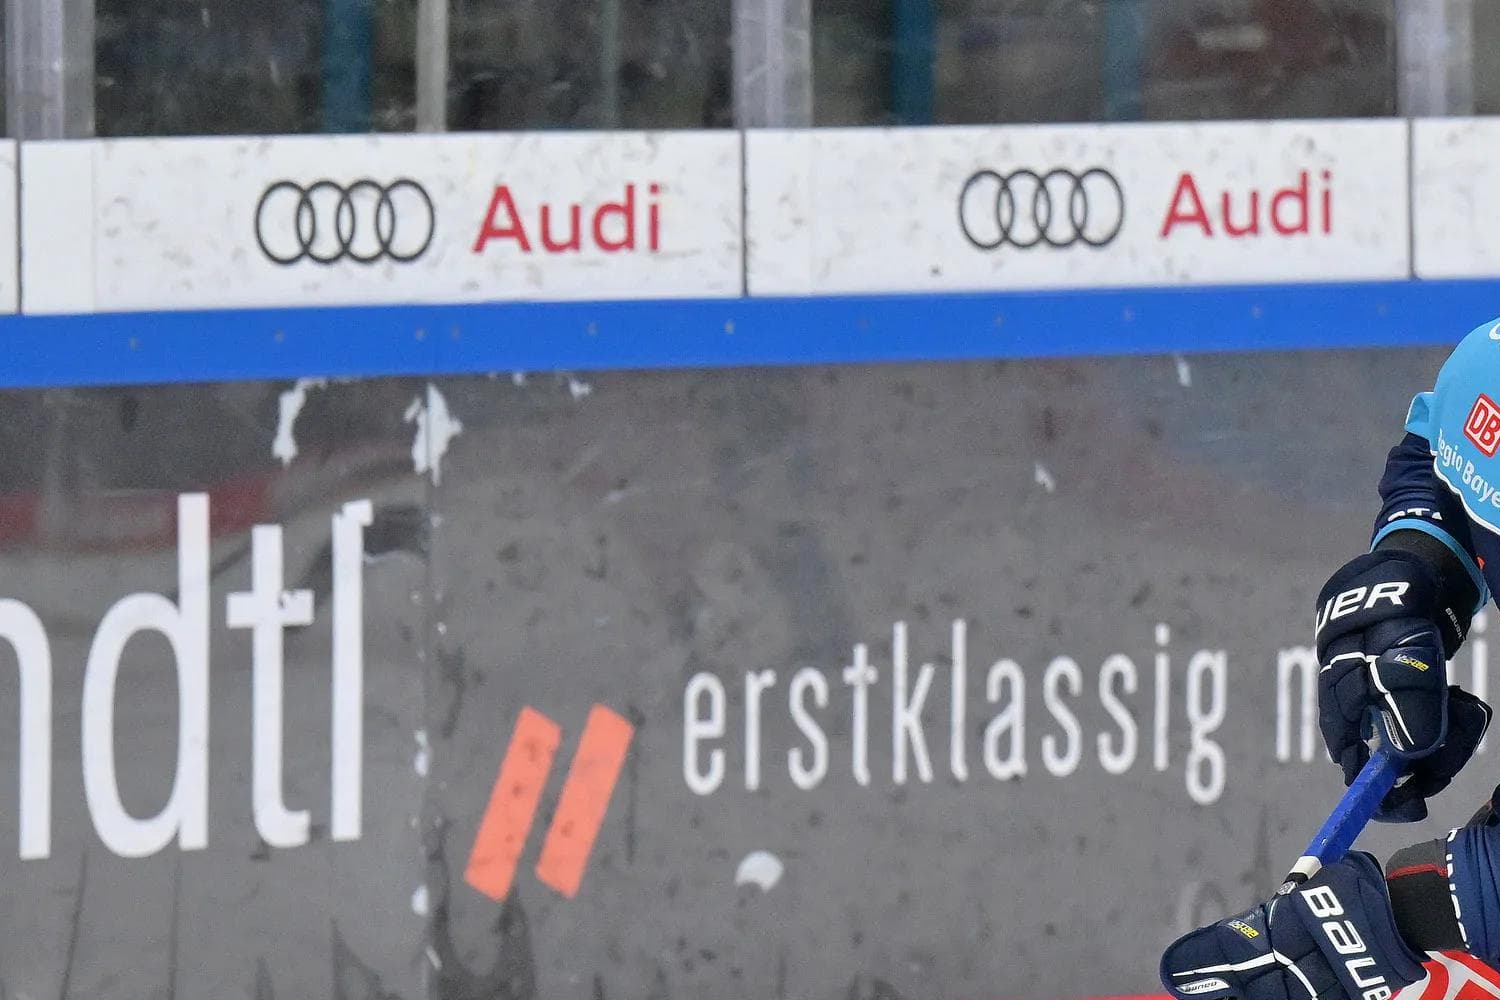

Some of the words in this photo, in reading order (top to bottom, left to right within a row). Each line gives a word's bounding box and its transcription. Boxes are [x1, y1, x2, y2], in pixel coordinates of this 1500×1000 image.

[472, 183, 660, 253] Audi
[1161, 170, 1332, 238] Audi
[1438, 428, 1463, 472] egio
[682, 619, 1227, 805] erstklassig
